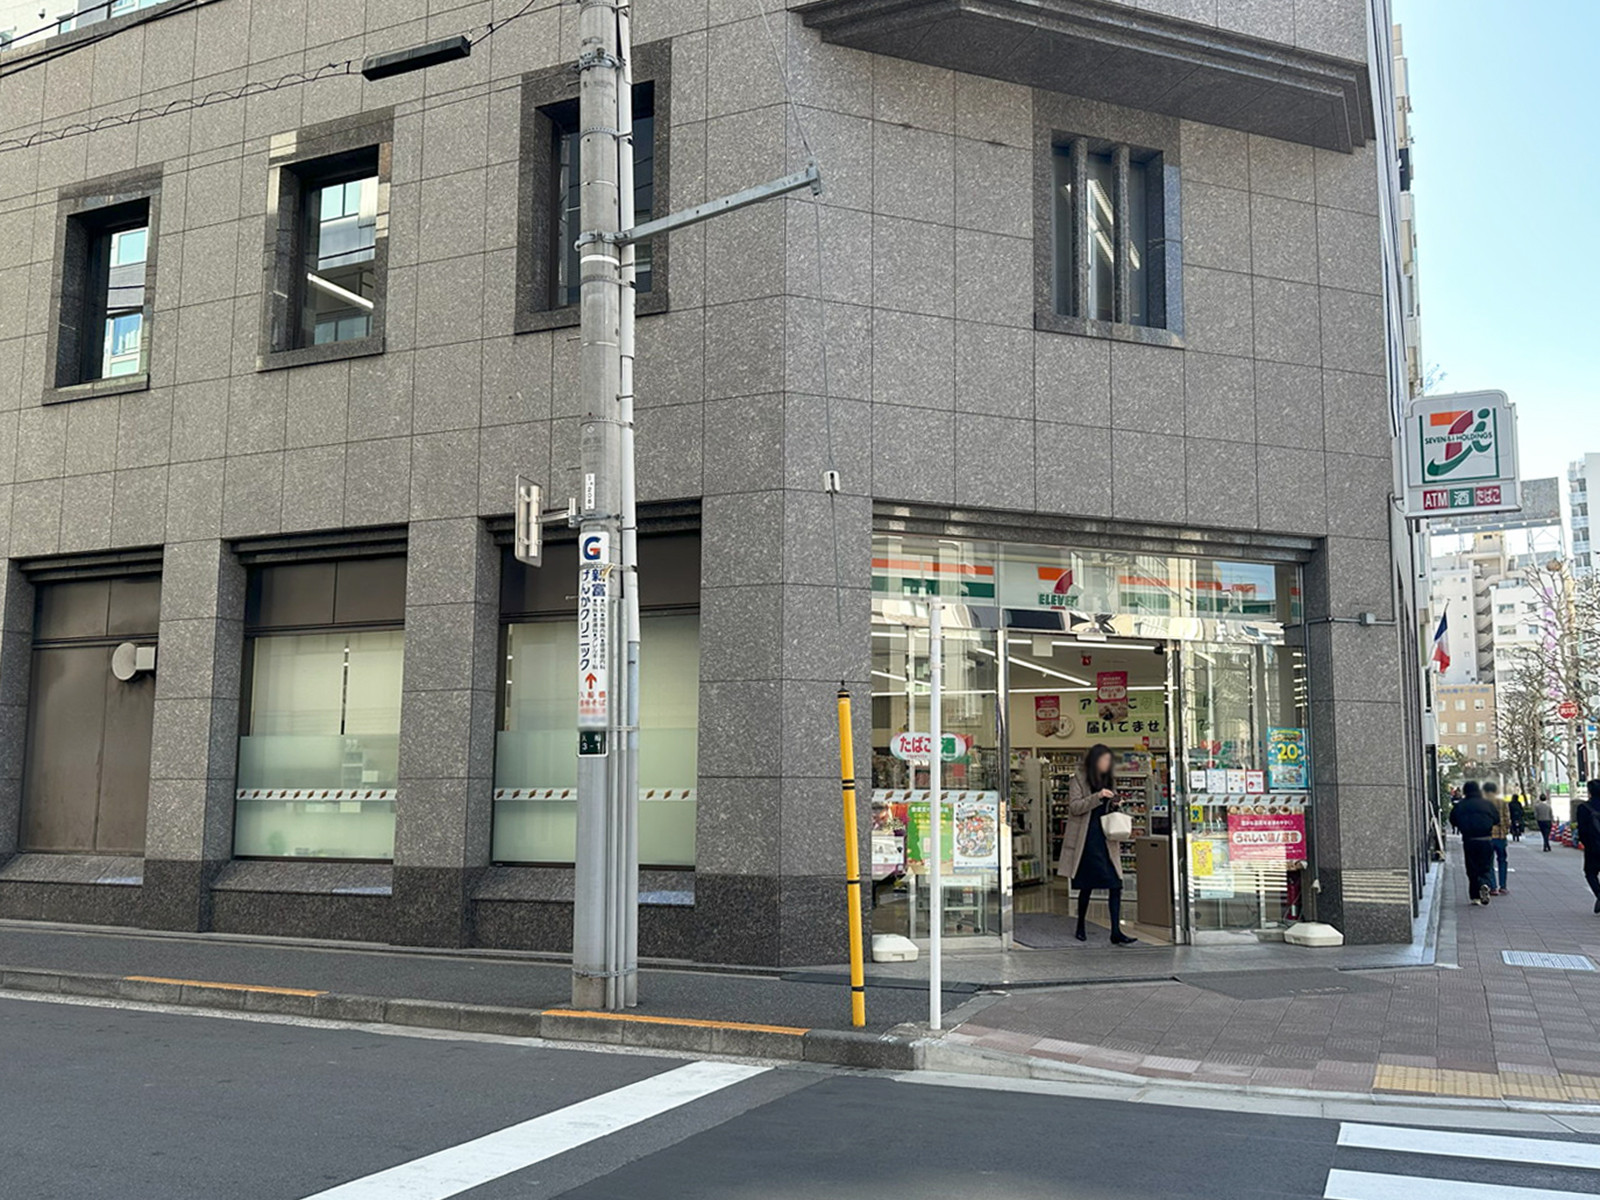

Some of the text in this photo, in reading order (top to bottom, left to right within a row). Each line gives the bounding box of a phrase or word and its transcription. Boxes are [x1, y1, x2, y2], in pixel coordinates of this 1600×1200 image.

[1456, 431, 1493, 442] HOLDINGS
[1425, 488, 1500, 508] ATM 酒 たばこ
[899, 736, 932, 753] たばこ
[1277, 743, 1299, 761] 20
